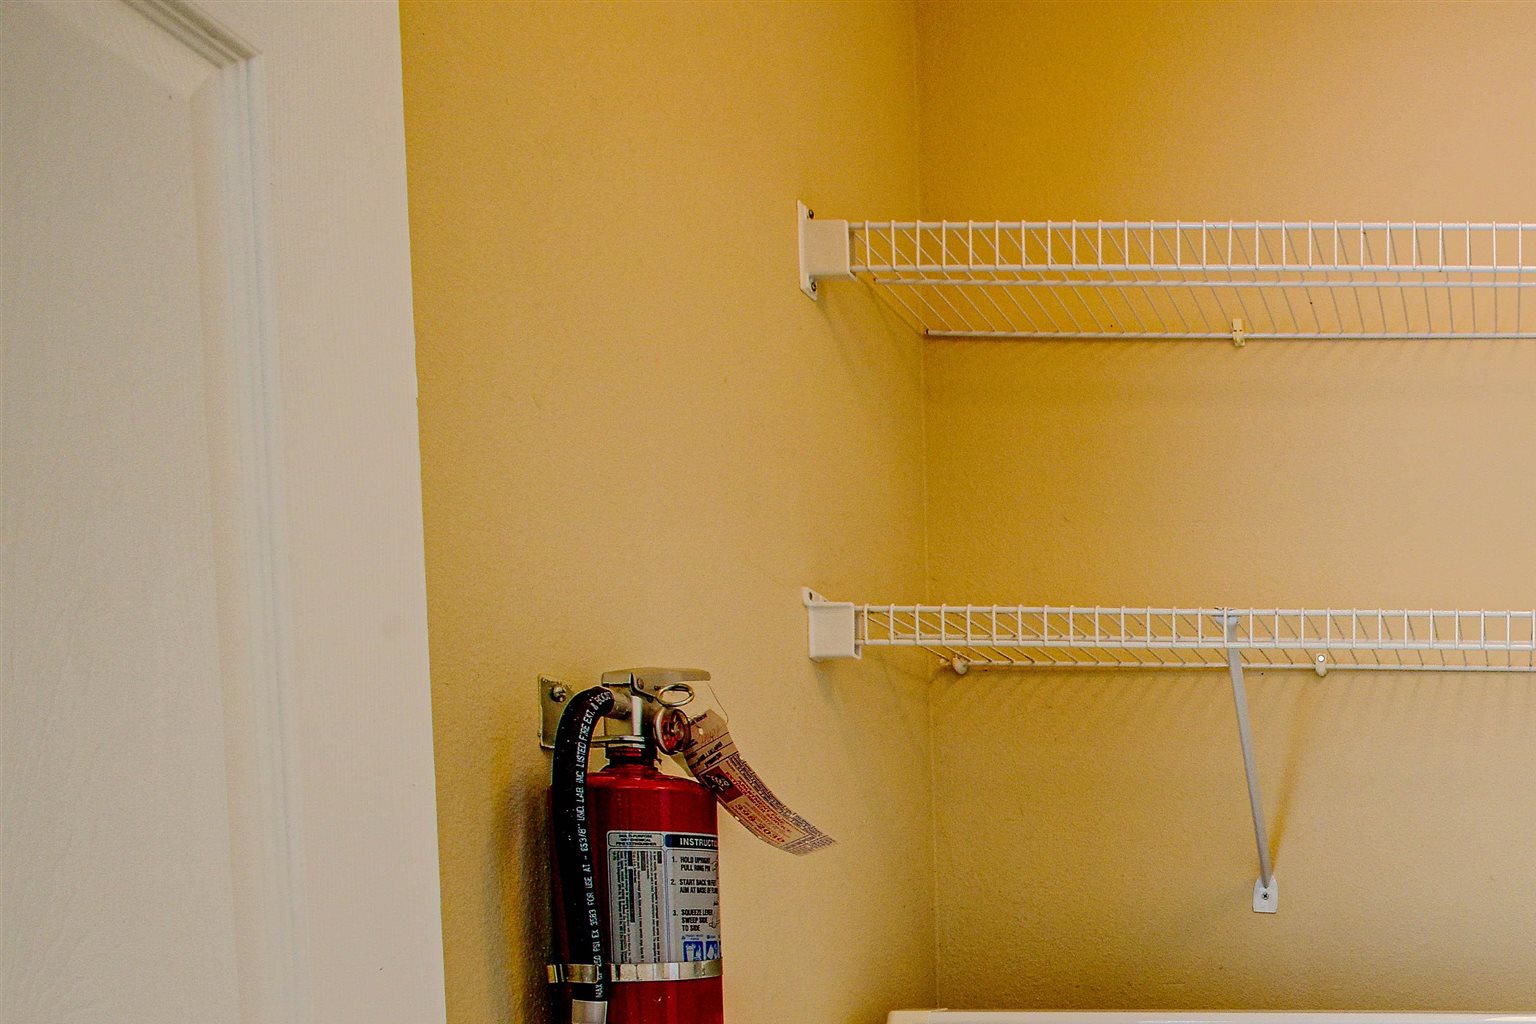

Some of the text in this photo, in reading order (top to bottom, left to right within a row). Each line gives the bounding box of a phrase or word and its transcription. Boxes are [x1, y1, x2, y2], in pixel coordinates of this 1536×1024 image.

[578, 722, 590, 741] FIRE
[576, 742, 587, 768] LISTED
[582, 864, 591, 872] AT
[584, 876, 593, 889] USE
[587, 892, 596, 906] FOR
[591, 930, 600, 940] EX
[592, 943, 601, 954] PSI
